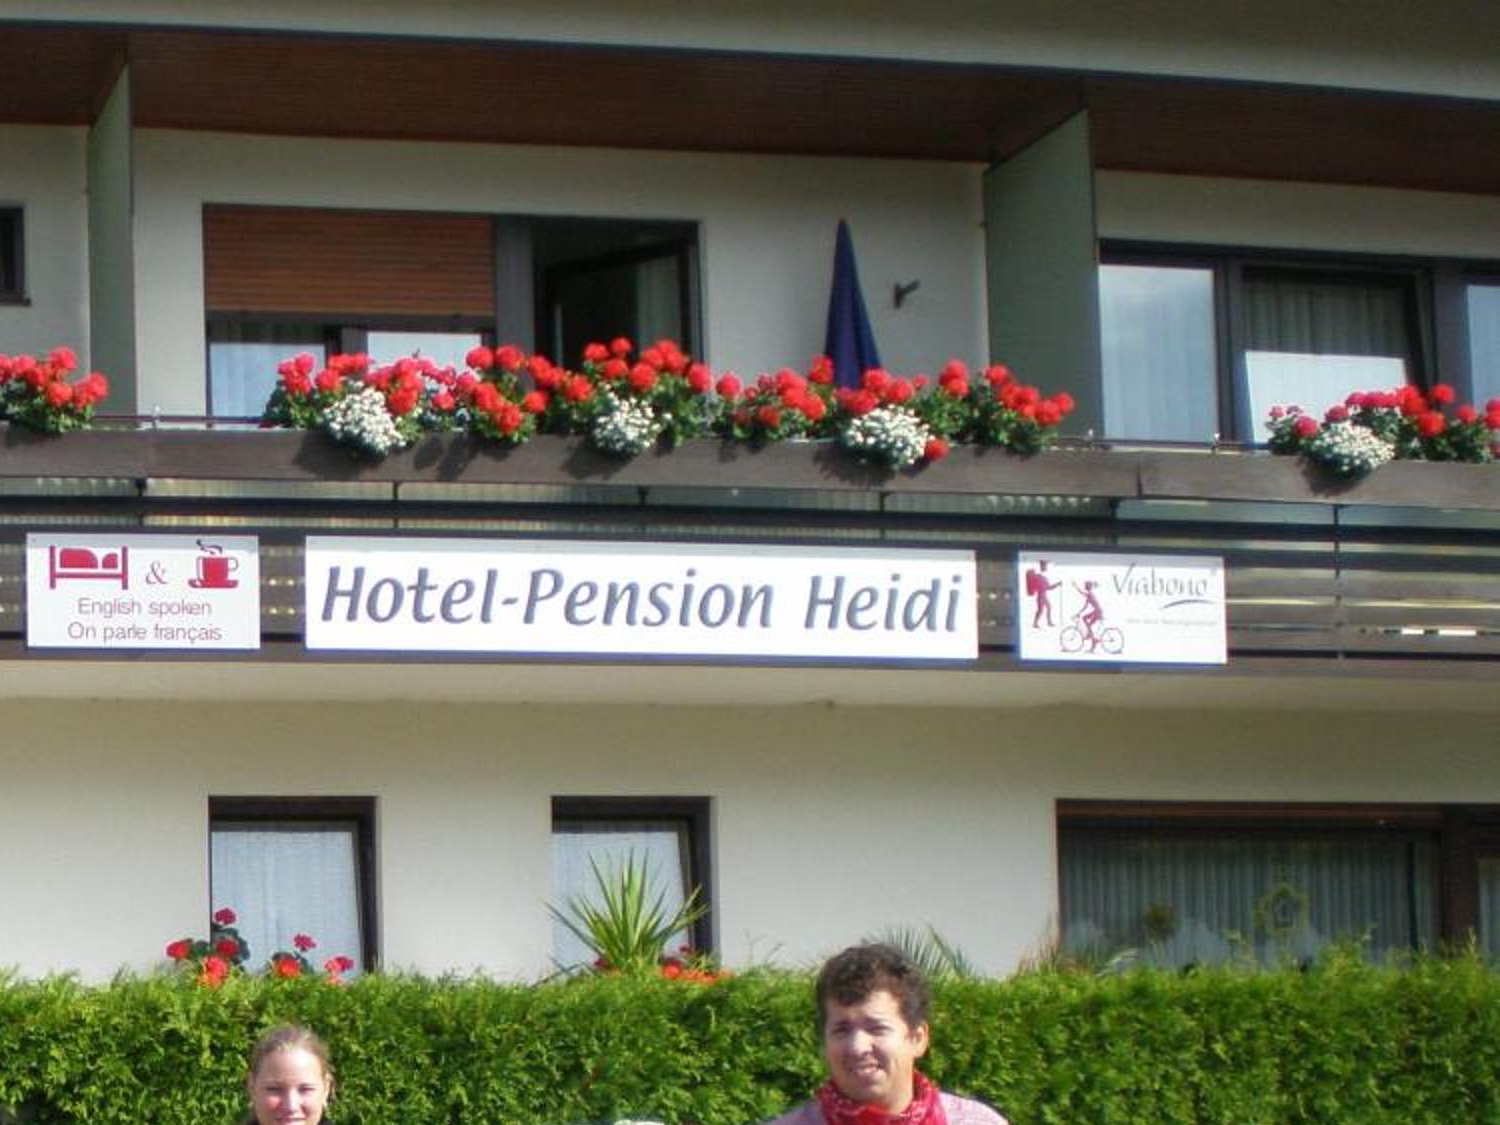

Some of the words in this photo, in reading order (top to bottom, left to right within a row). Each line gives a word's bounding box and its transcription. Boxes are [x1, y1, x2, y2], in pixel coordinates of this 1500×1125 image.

[145, 561, 169, 585] &
[1112, 562, 1208, 597] Viabono
[77, 597, 142, 619] English
[147, 598, 213, 620] spoken
[320, 565, 775, 629] Hotel-Pension
[803, 572, 964, 633] Heidi
[67, 621, 97, 640] On
[103, 621, 147, 643] parle
[153, 622, 223, 645] français
